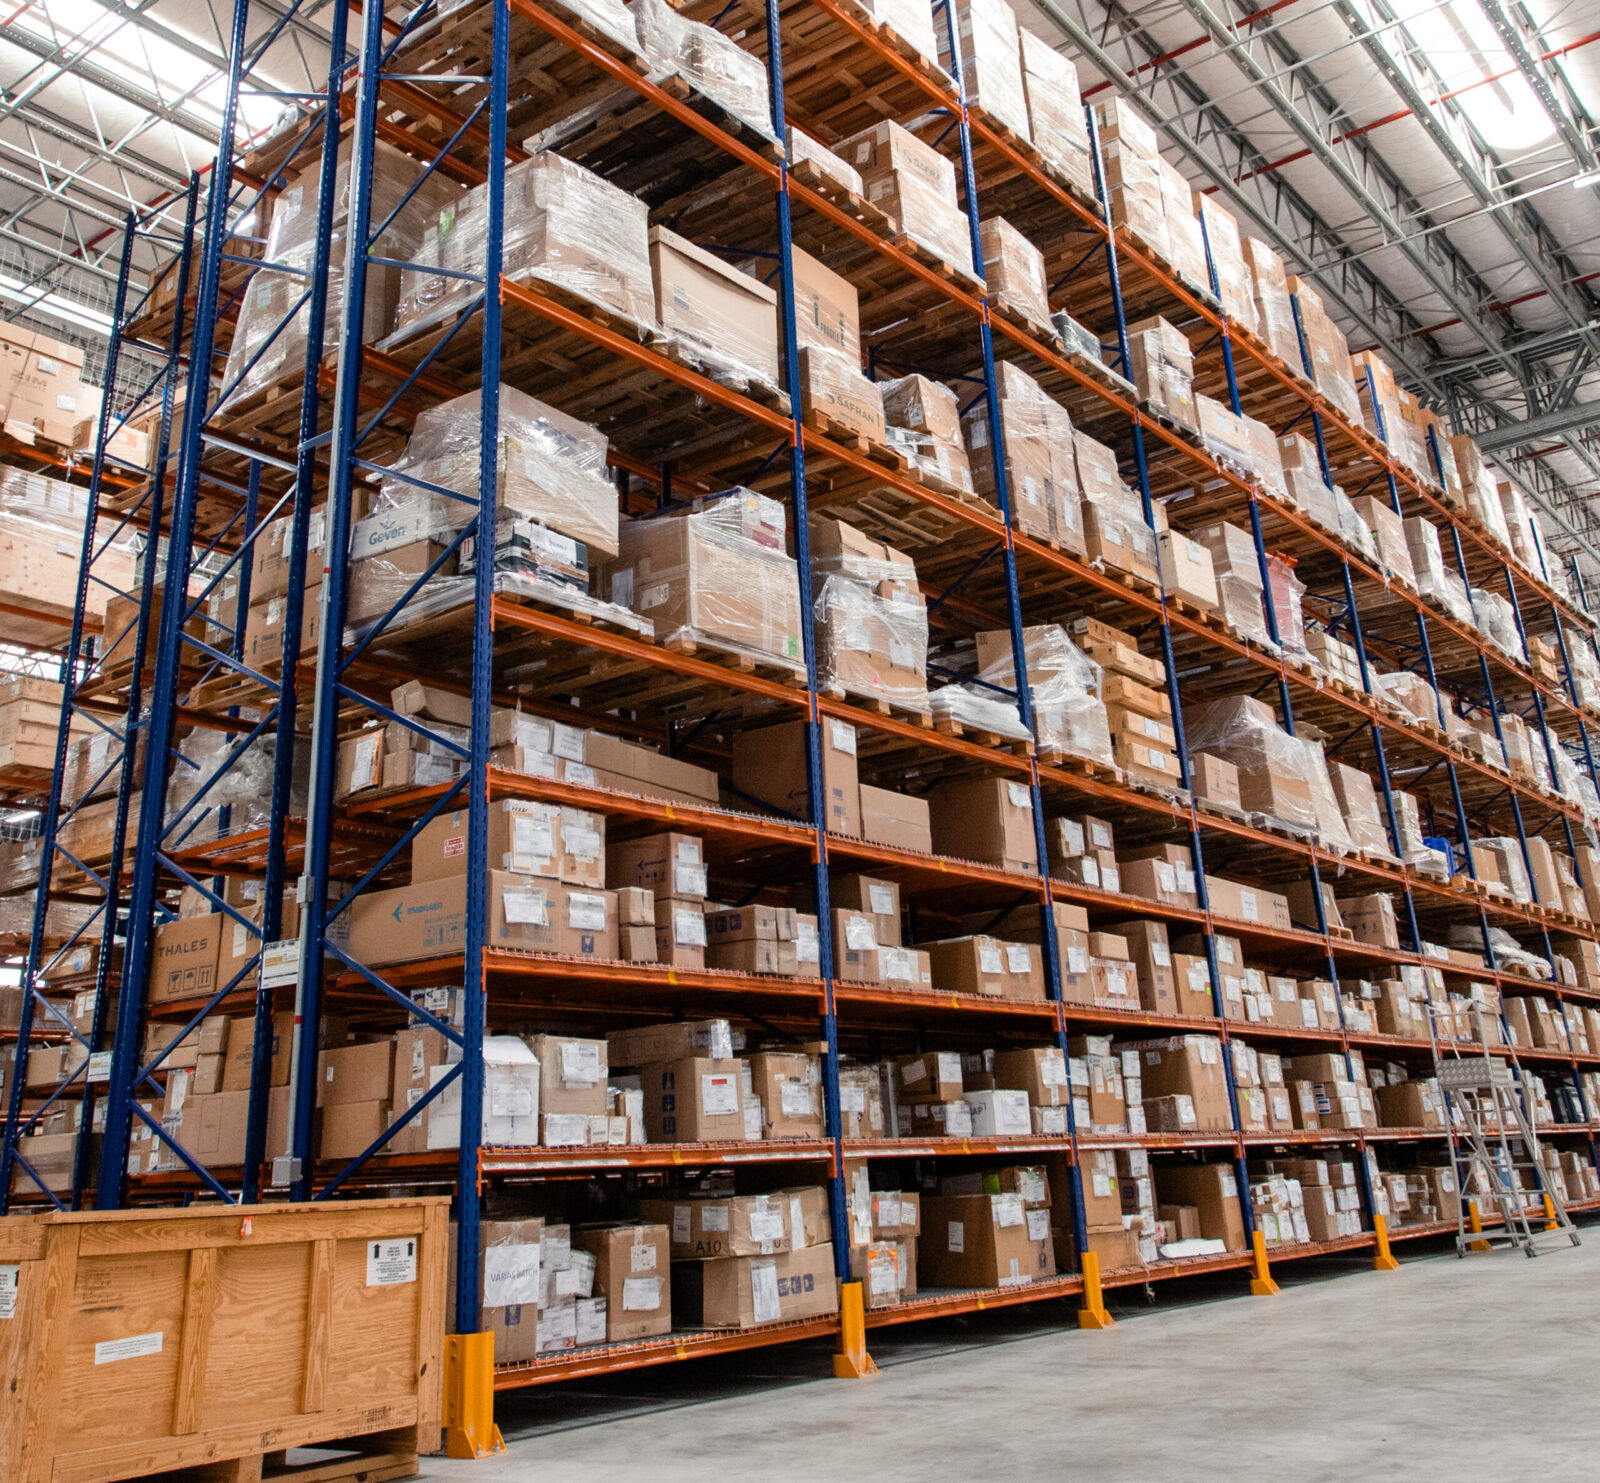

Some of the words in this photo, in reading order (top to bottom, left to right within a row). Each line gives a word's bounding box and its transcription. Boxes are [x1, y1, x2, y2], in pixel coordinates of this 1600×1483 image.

[837, 396, 875, 425] SAFRAN
[368, 526, 407, 545] Geven
[158, 938, 208, 958] THALES
